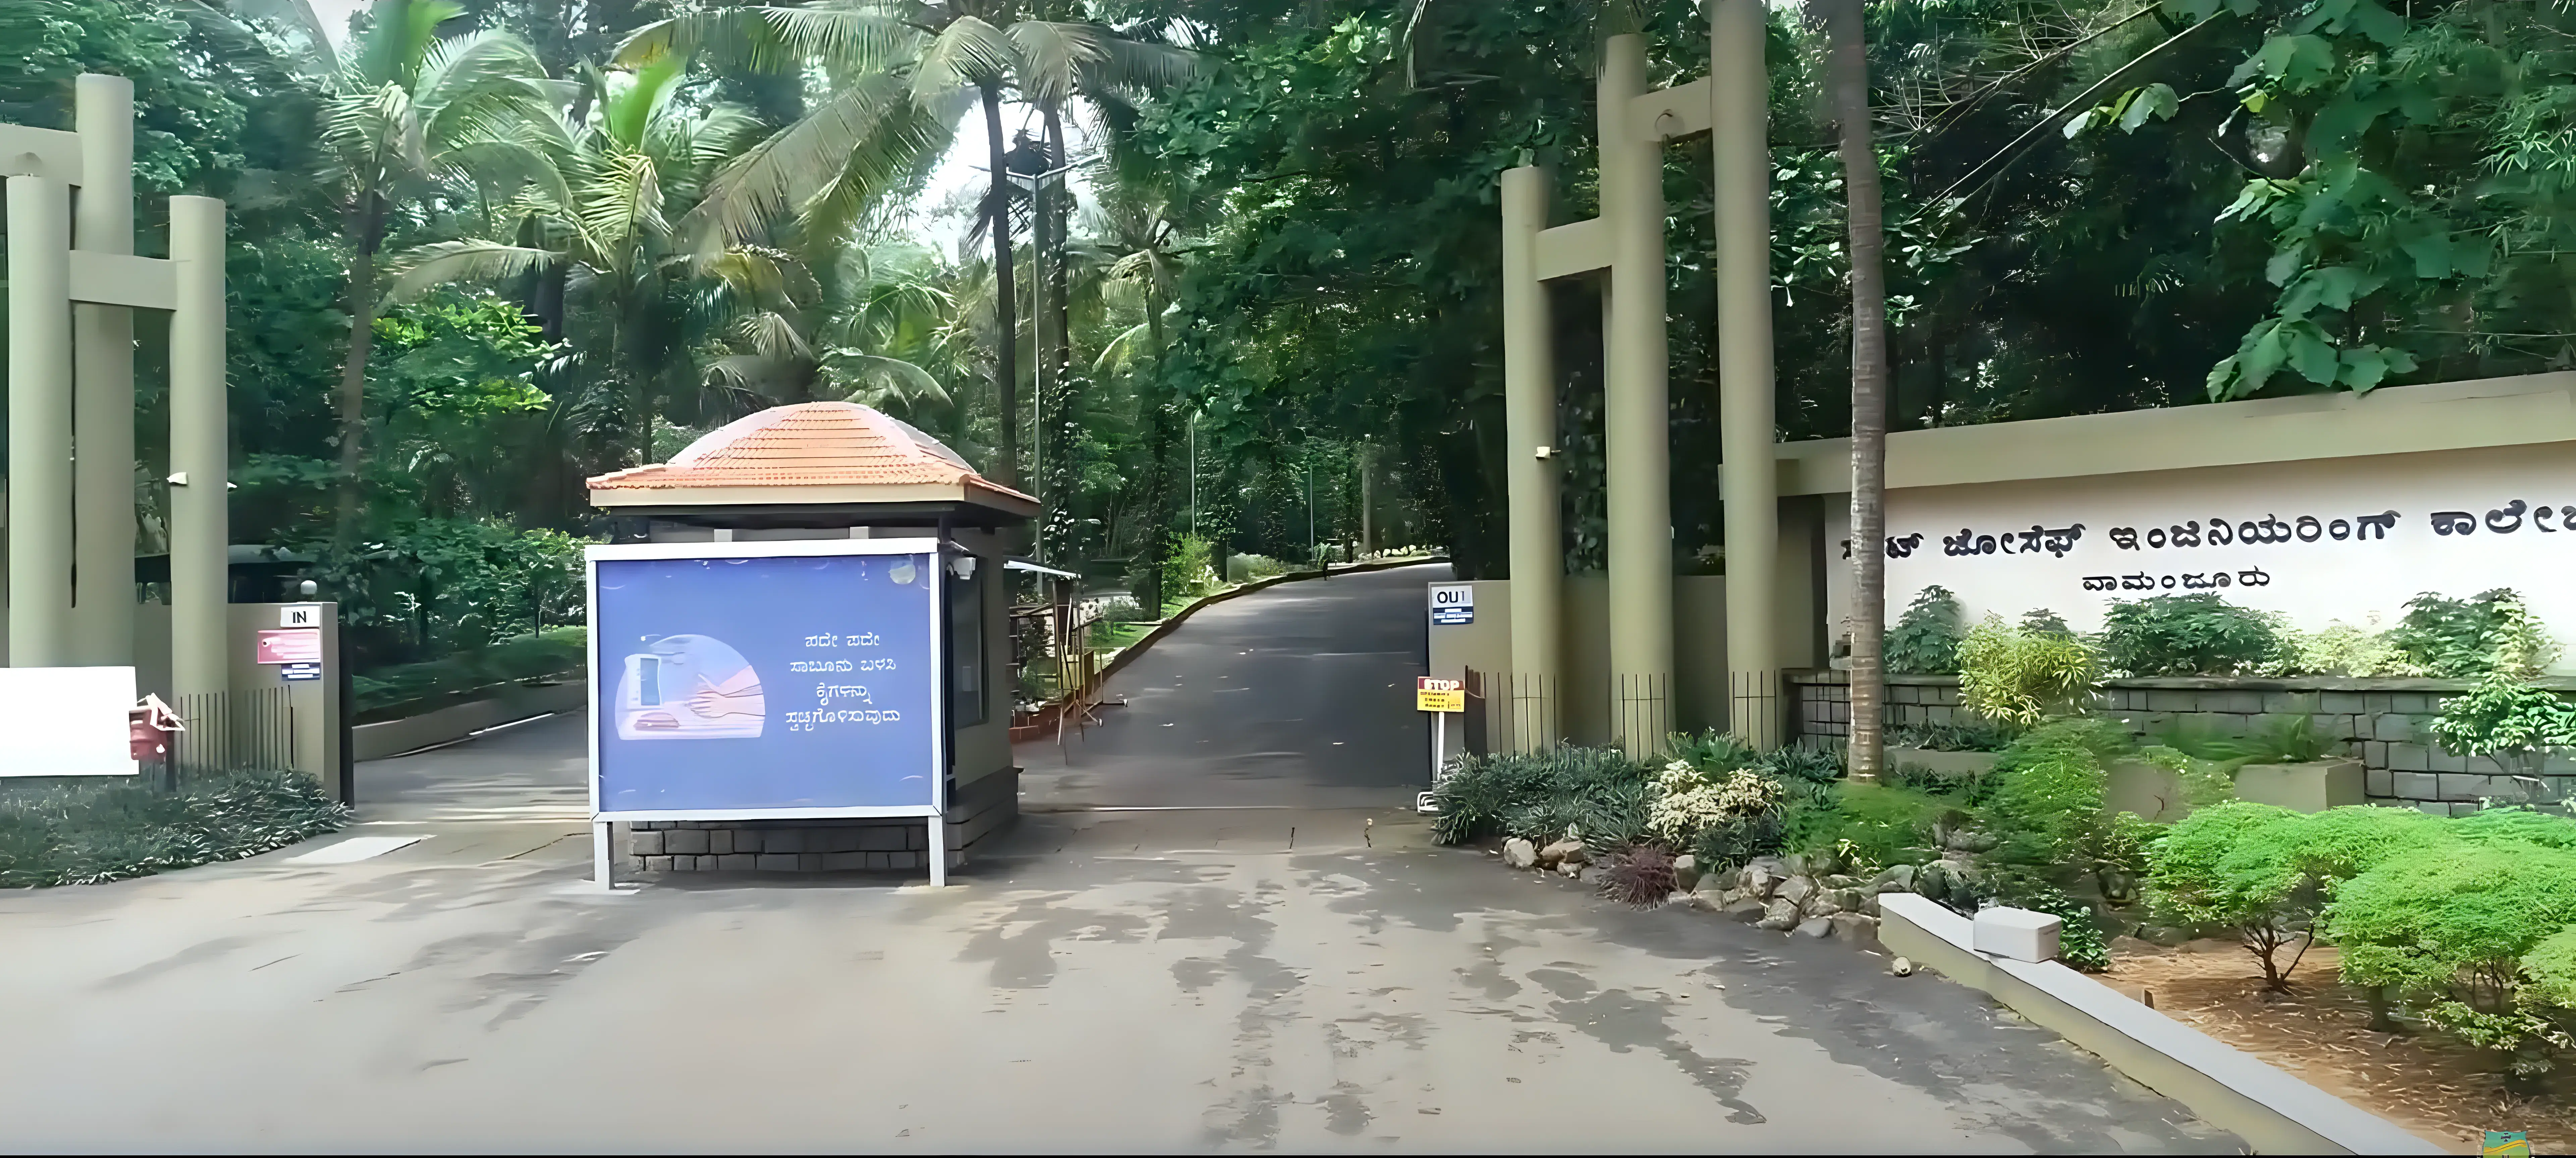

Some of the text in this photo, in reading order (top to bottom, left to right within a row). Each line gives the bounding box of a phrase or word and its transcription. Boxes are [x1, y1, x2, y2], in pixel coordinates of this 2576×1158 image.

[1943, 523, 2086, 558] ಜೋಸೆಫ್
[291, 611, 307, 623] IN
[805, 632, 879, 647] ಪದೇ ಪದೇ
